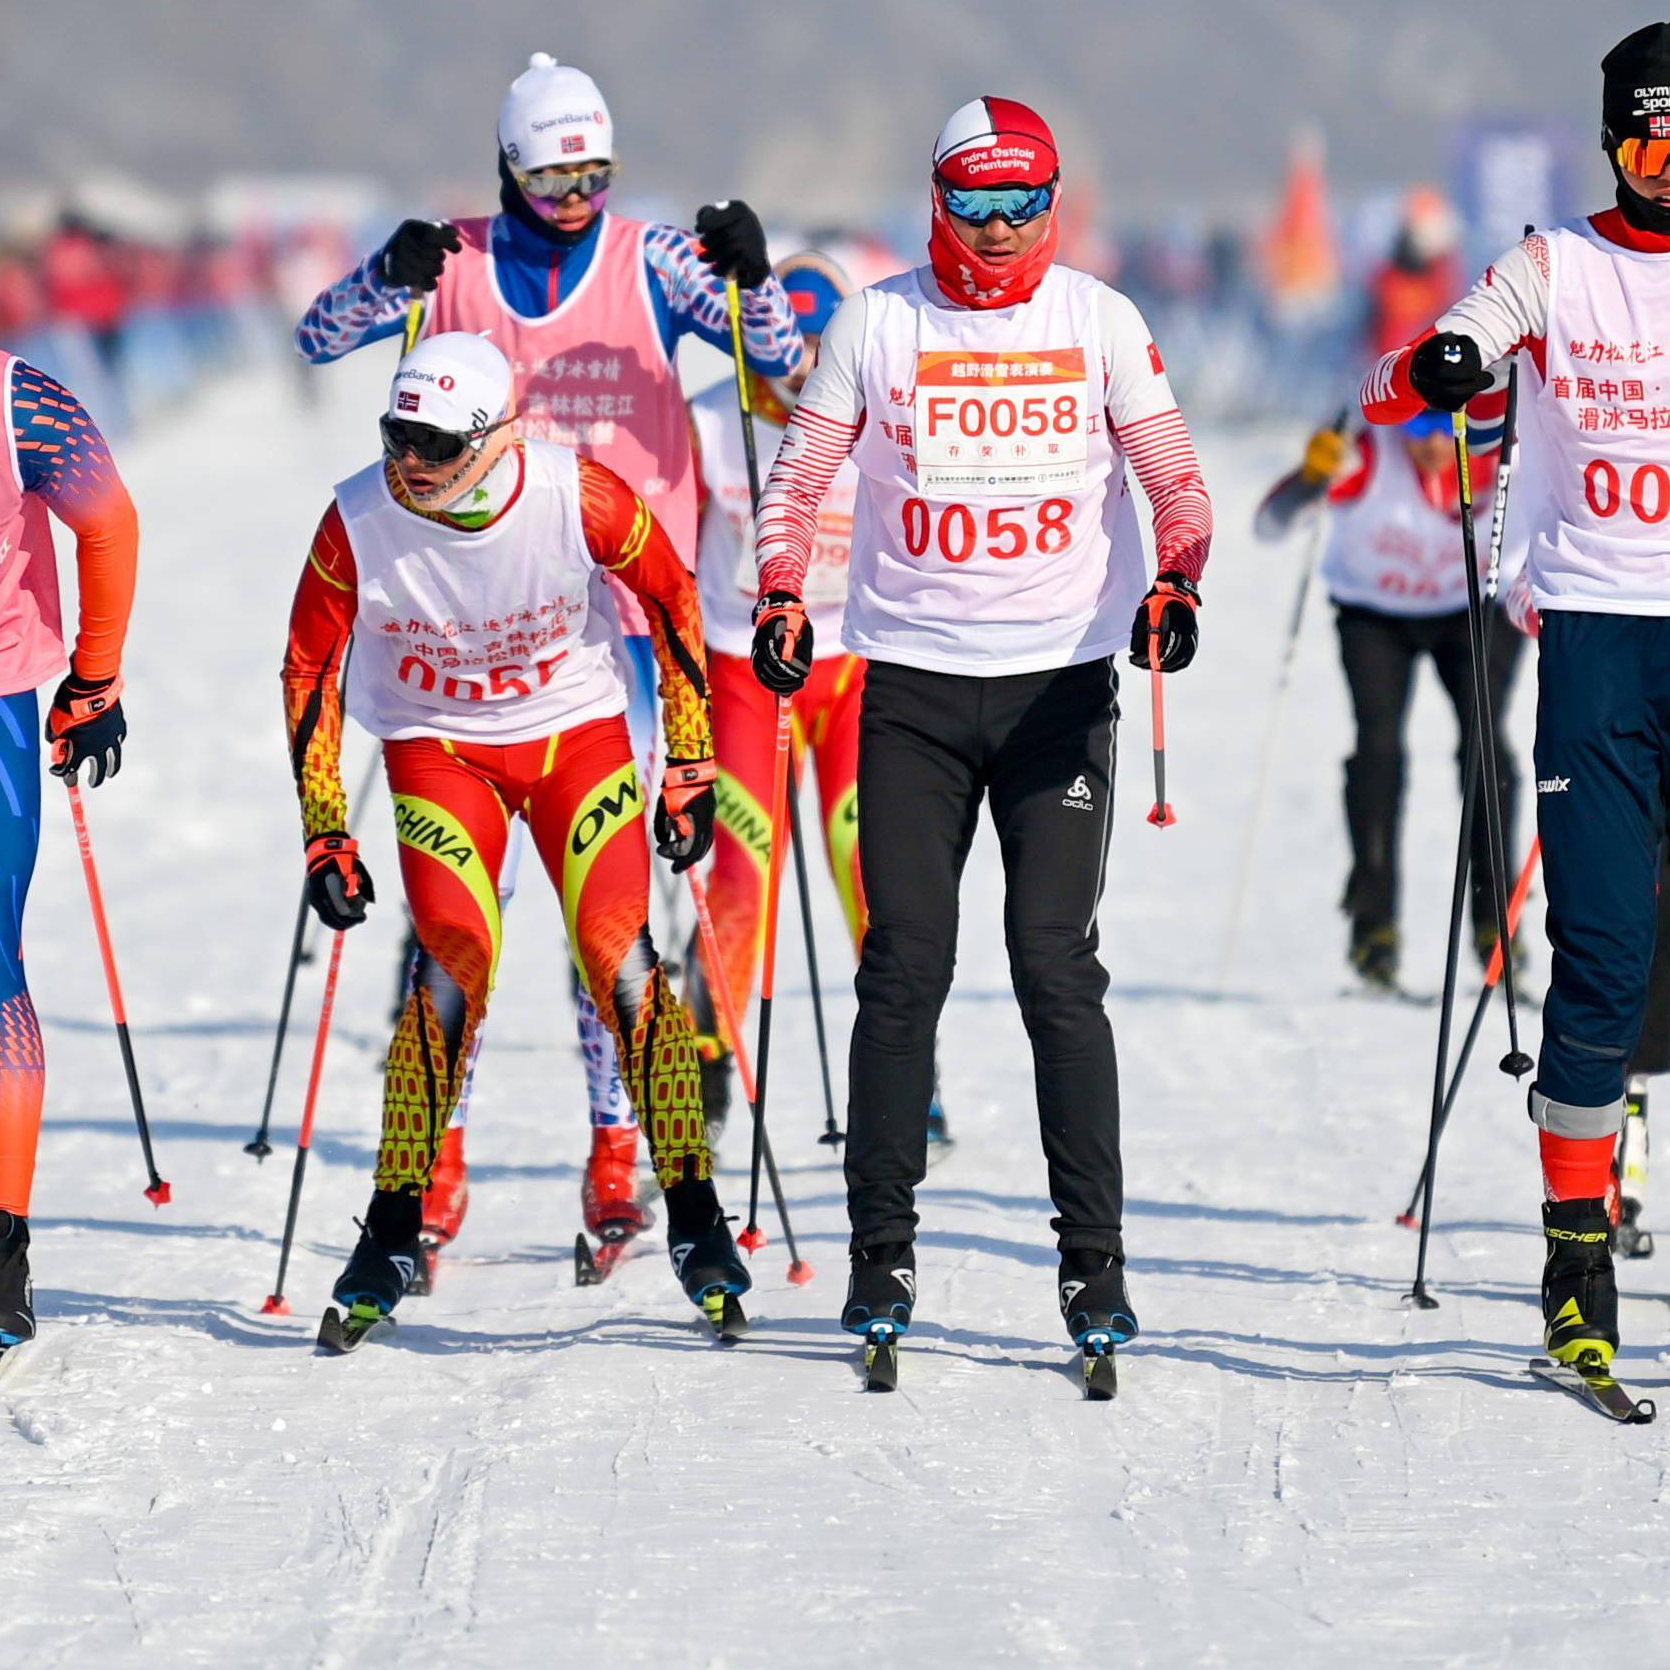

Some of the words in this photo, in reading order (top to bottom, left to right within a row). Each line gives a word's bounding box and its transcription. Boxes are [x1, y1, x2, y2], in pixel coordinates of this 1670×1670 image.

[531, 113, 592, 131] SpareBank
[961, 151, 988, 166] Indre
[968, 158, 1029, 174] Orientering
[1569, 338, 1664, 368] 魅力松花江
[951, 362, 1054, 378] 越野滑雪表演赛
[928, 395, 1078, 437] F0058
[902, 497, 1074, 563] 0058
[1538, 775, 1571, 793] swix
[1062, 799, 1094, 811] odlo
[395, 803, 473, 867] CHINA
